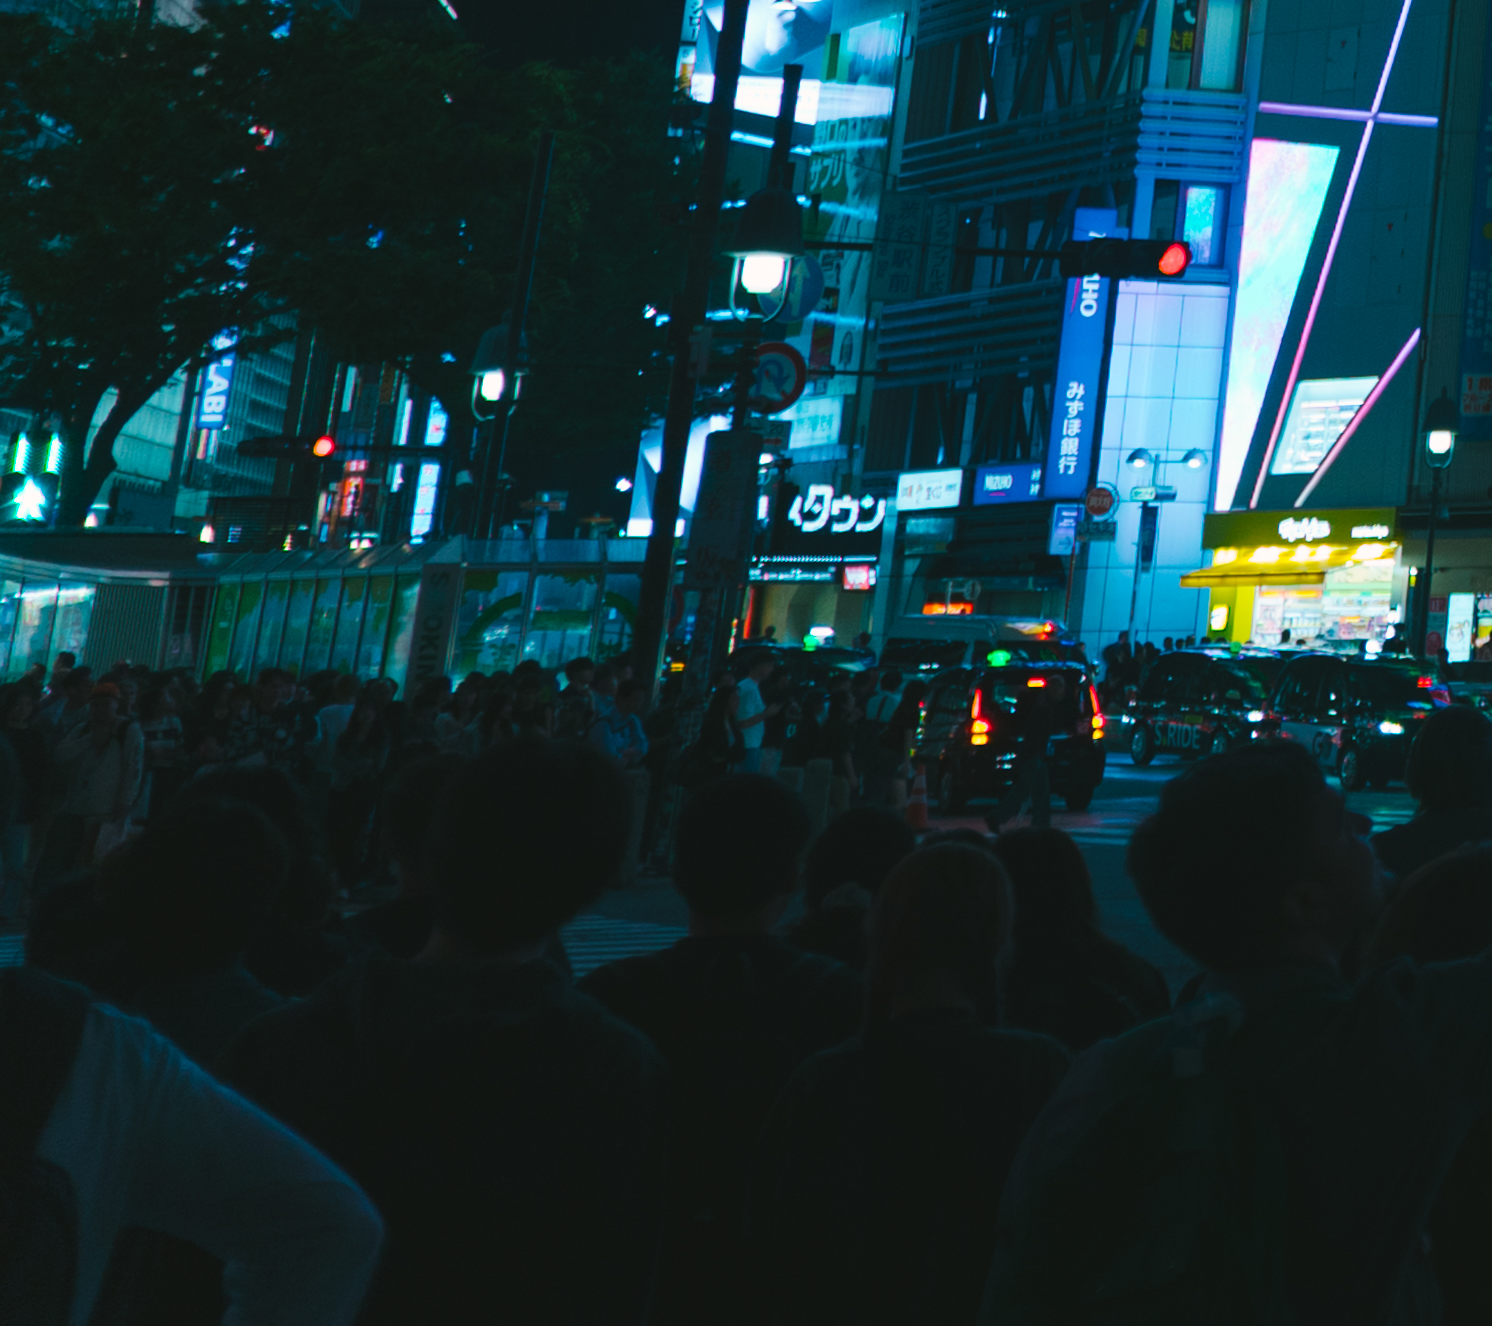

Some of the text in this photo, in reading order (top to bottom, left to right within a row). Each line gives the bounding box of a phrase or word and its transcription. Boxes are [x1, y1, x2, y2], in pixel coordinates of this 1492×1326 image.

[1059, 381, 1086, 475] みずほ銀行
